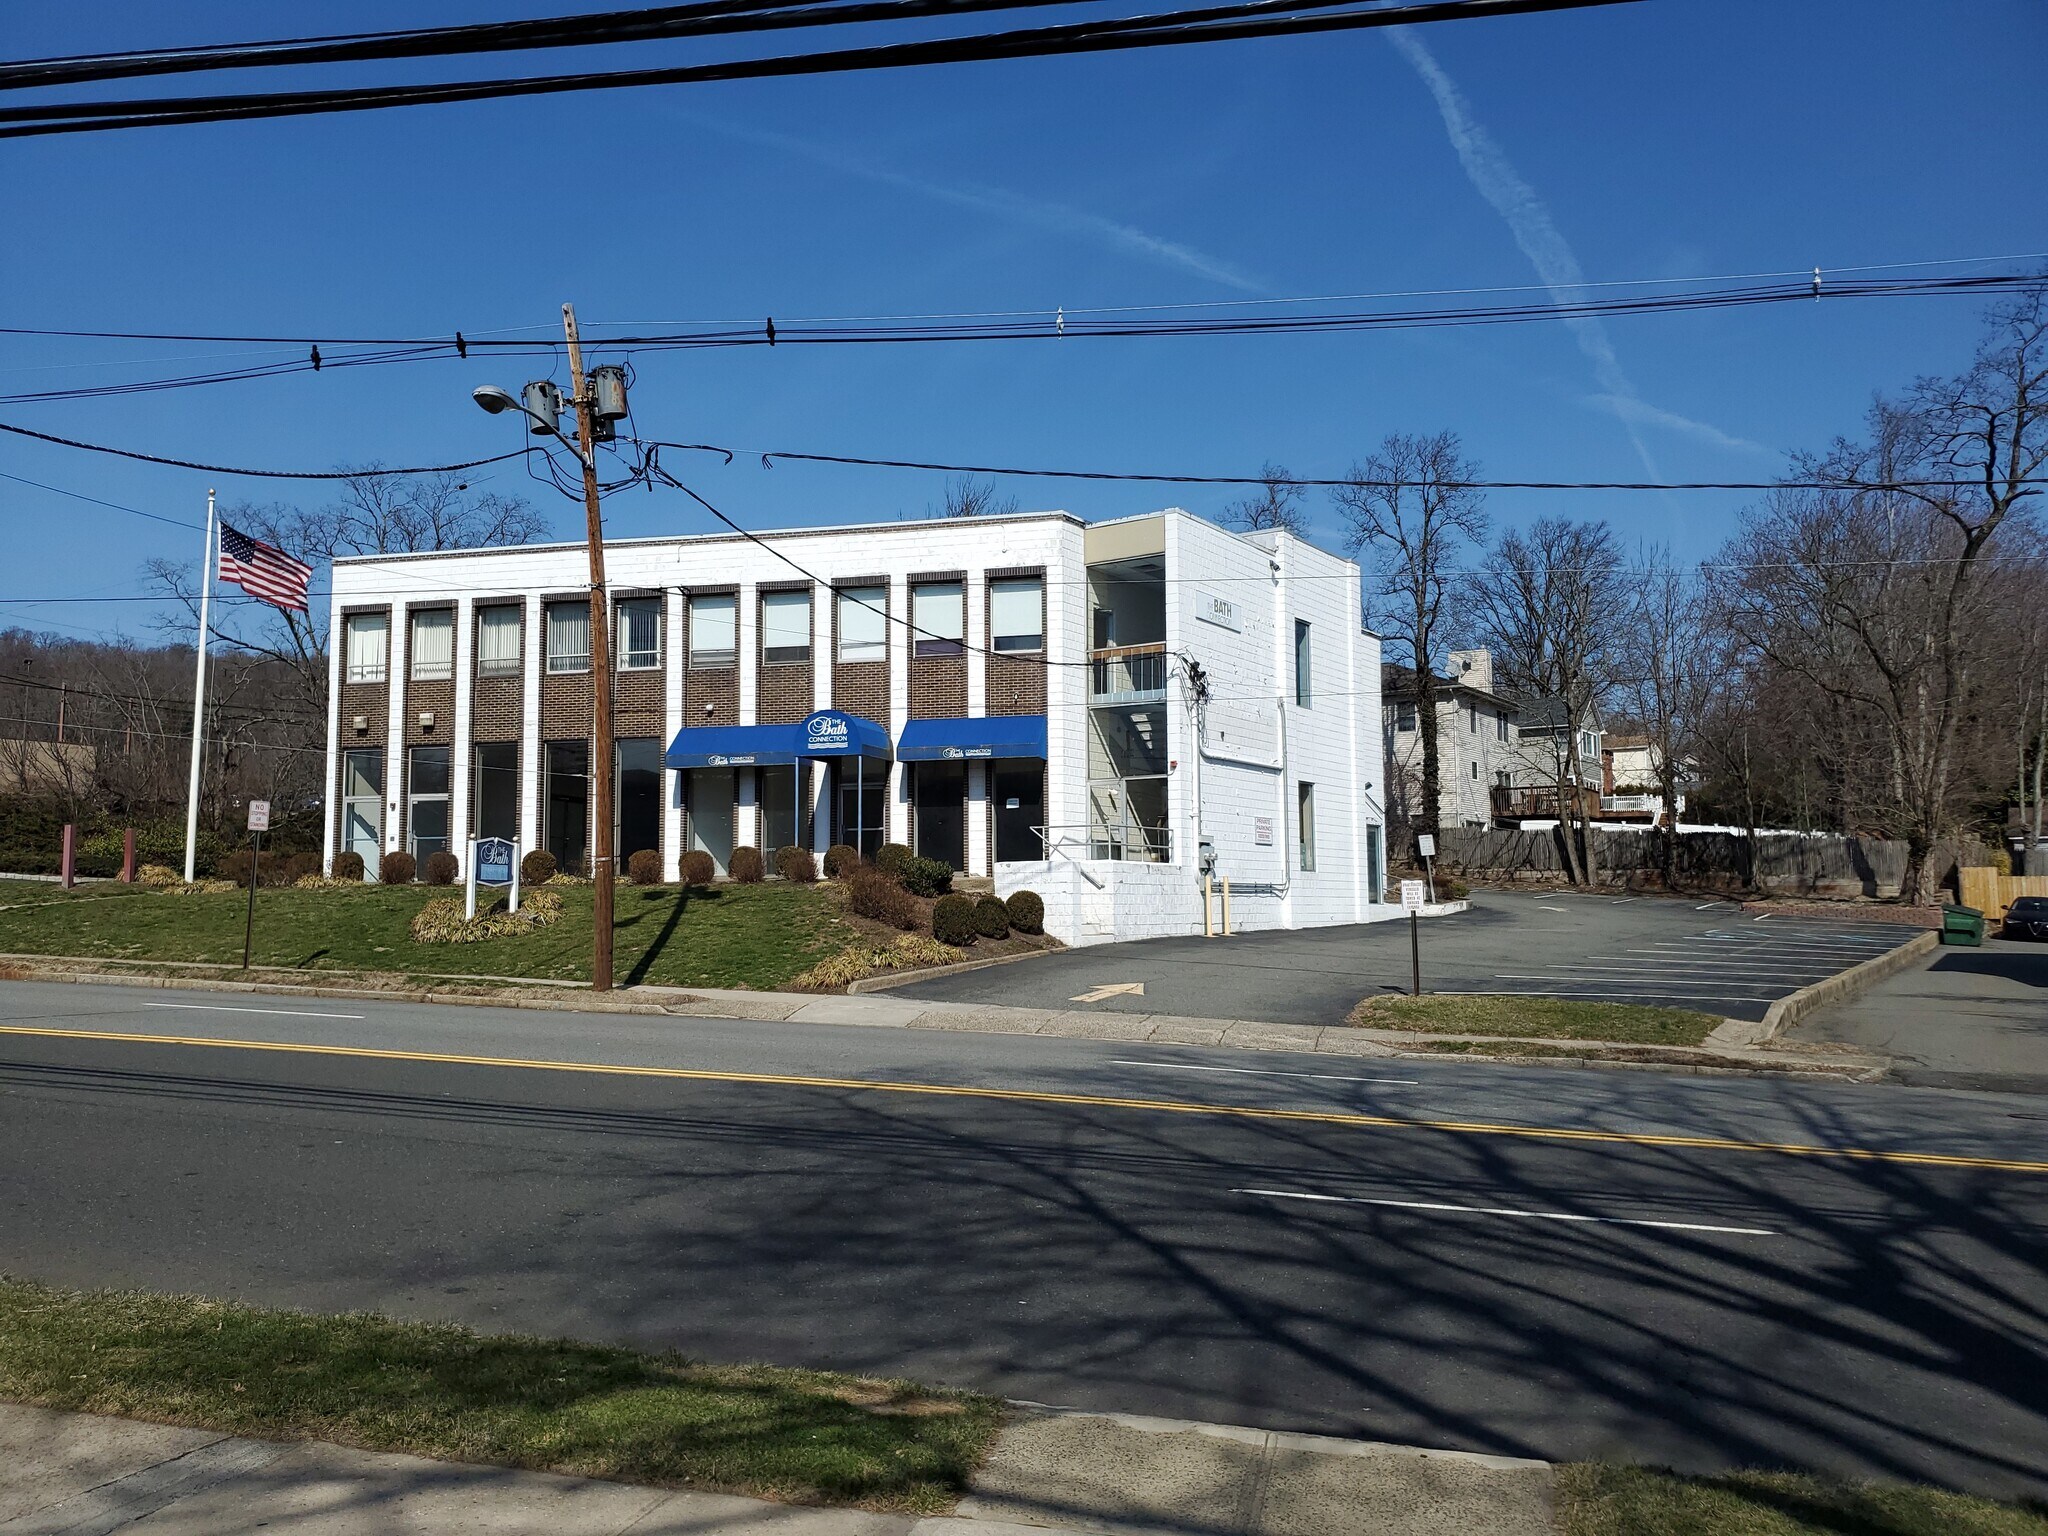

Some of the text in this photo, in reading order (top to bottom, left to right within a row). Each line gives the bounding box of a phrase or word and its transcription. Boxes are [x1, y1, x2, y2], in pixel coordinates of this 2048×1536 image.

[1213, 598, 1232, 618] BATH
[807, 716, 848, 736] Bath
[481, 842, 509, 864] Bath
